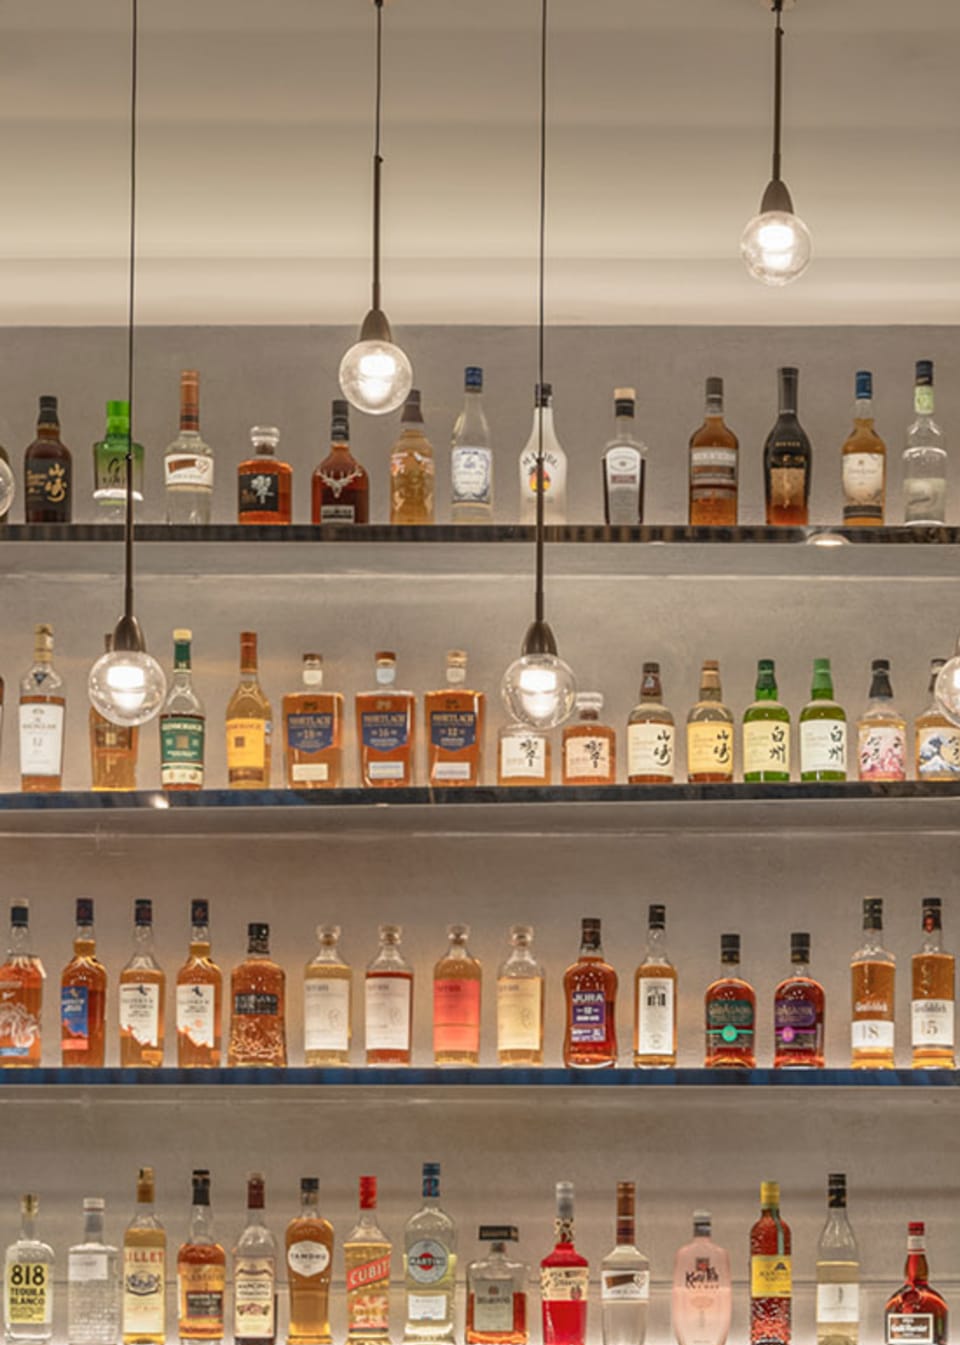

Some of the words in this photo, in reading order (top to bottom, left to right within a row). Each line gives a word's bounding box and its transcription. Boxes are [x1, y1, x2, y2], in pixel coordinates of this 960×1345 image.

[862, 1023, 880, 1040] 18
[409, 1256, 446, 1266] MARTINI
[11, 1264, 45, 1286] 818
[10, 1287, 46, 1296] TEQUILA
[10, 1297, 45, 1305] BLANCO
